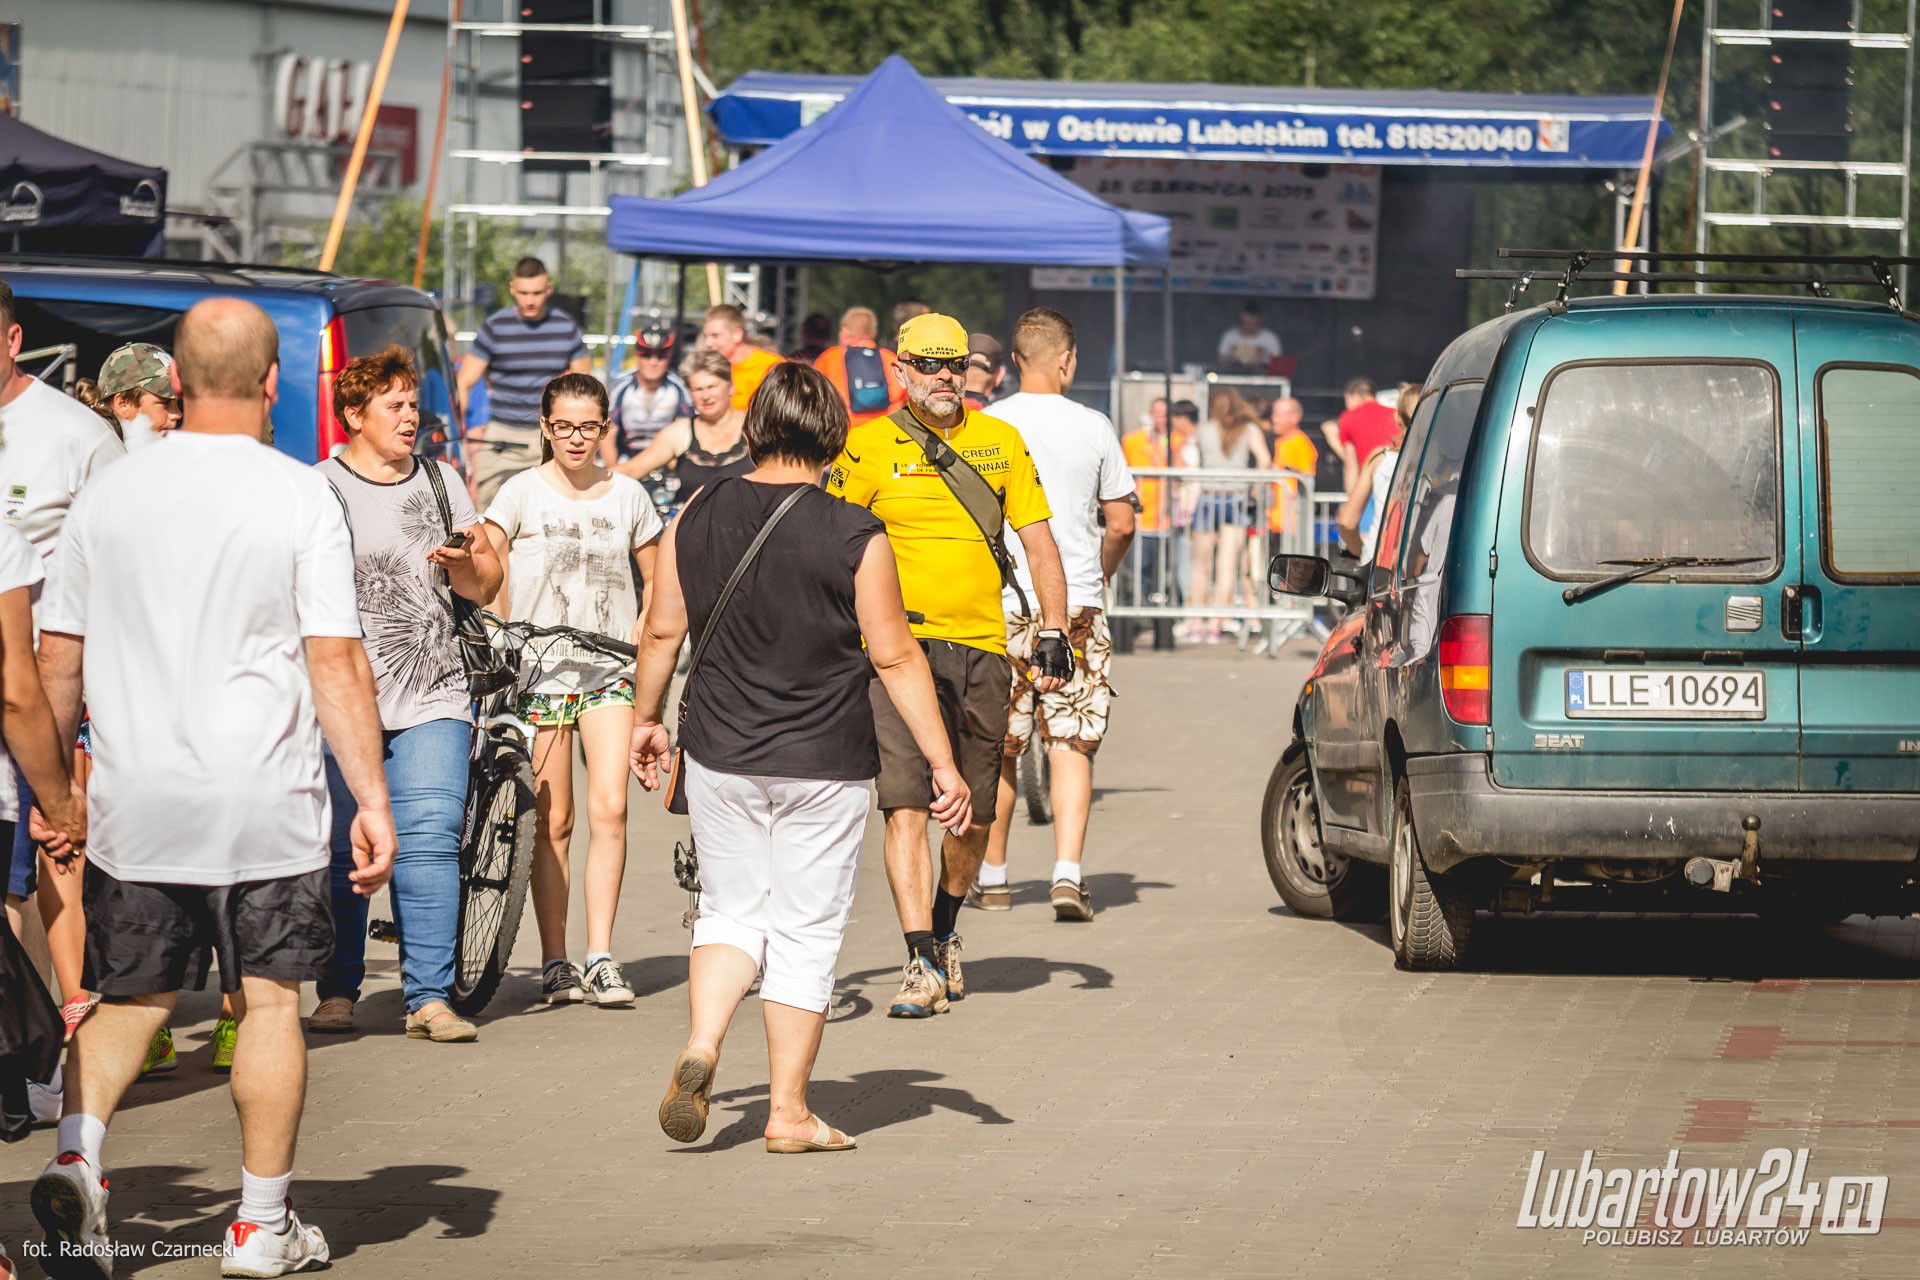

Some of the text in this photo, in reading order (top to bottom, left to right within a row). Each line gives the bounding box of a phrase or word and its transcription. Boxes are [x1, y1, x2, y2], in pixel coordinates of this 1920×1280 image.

[1021, 119, 1051, 141] w
[1058, 115, 1183, 144] Ostrowie
[1188, 118, 1328, 148] Lubelskim
[1336, 122, 1383, 149] tel.
[1387, 123, 1533, 152] 818520040
[962, 447, 1000, 458] CREDIT
[970, 460, 1010, 472] ONNAIS
[1588, 675, 1760, 707] LLE 10694
[1570, 694, 1583, 705] PL
[1534, 734, 1584, 749] SEAT
[1898, 740, 1920, 752] IN
